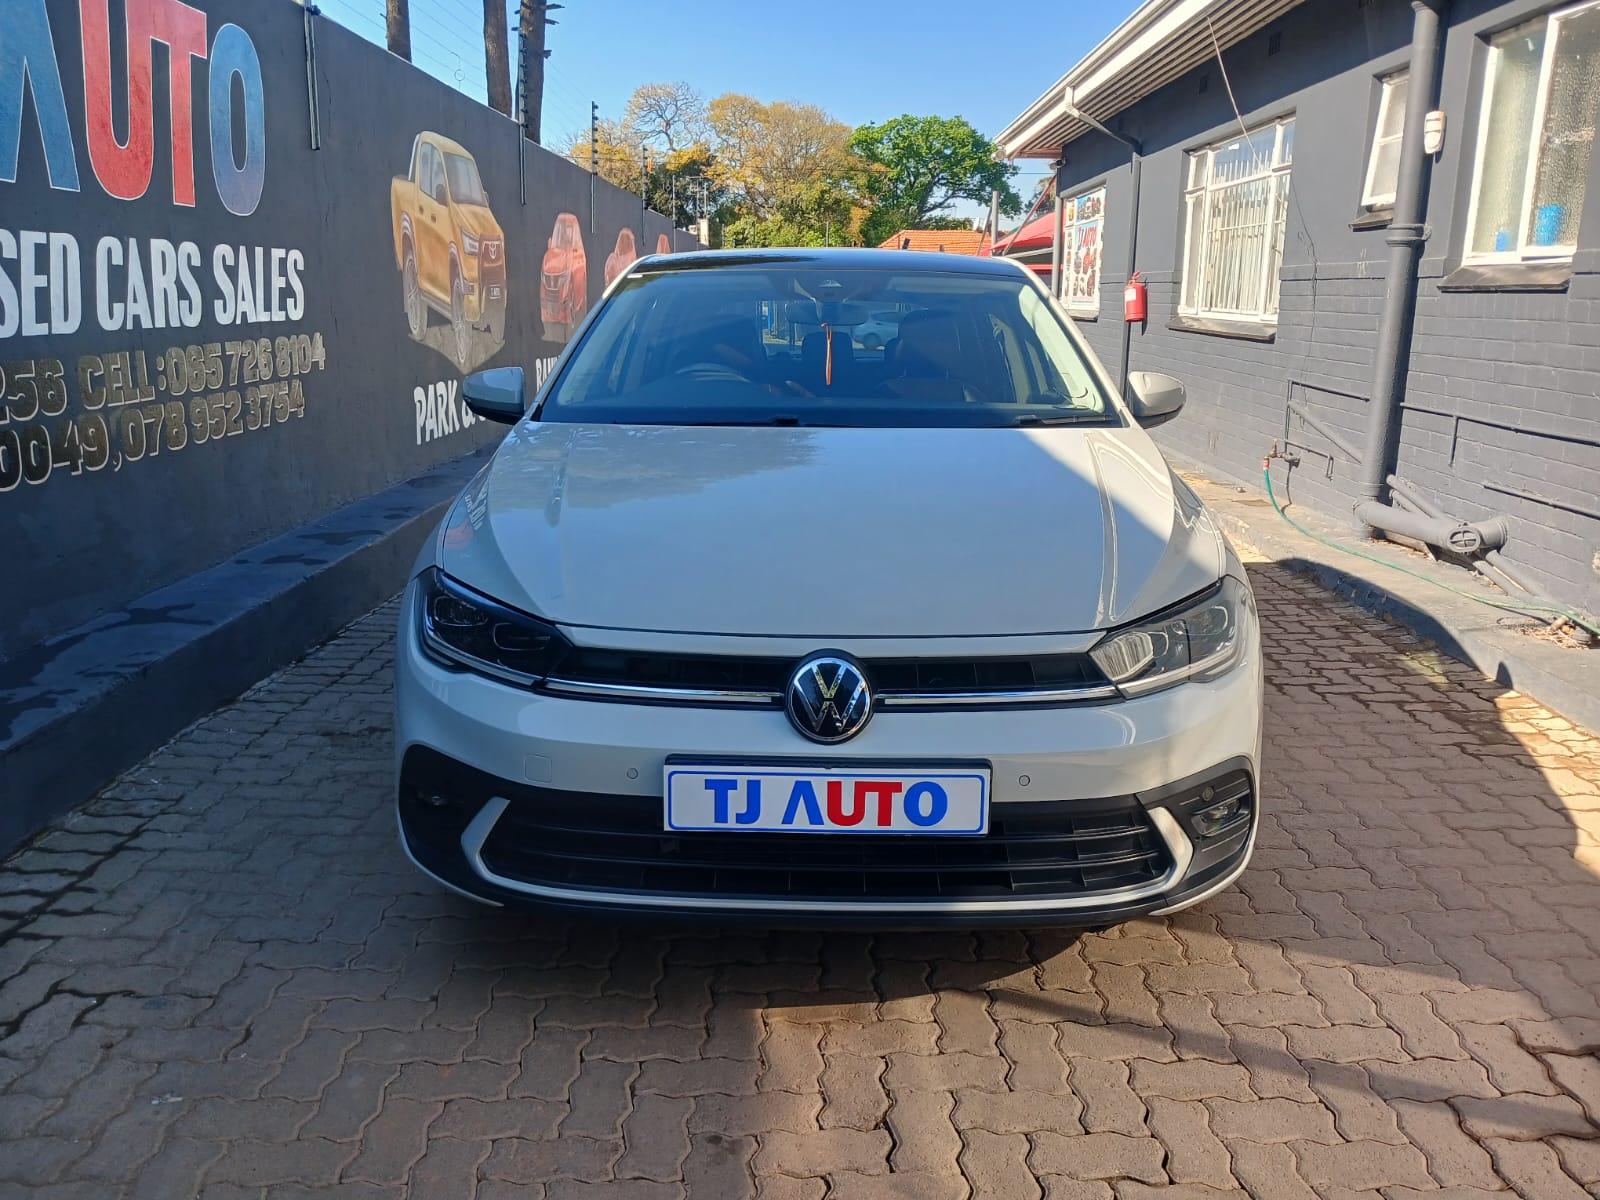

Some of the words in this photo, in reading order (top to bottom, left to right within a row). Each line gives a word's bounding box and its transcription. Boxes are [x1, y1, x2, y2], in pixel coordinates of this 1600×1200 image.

[96, 235, 202, 331] CARS
[212, 243, 305, 325] SALES
[0, 358, 67, 424] 56
[225, 337, 273, 386] 726
[275, 331, 326, 378] 8104
[190, 391, 244, 444] 952
[245, 379, 306, 432] 3754
[413, 379, 460, 446] PARK
[704, 778, 762, 825] TJ
[781, 780, 948, 827] AUTO
